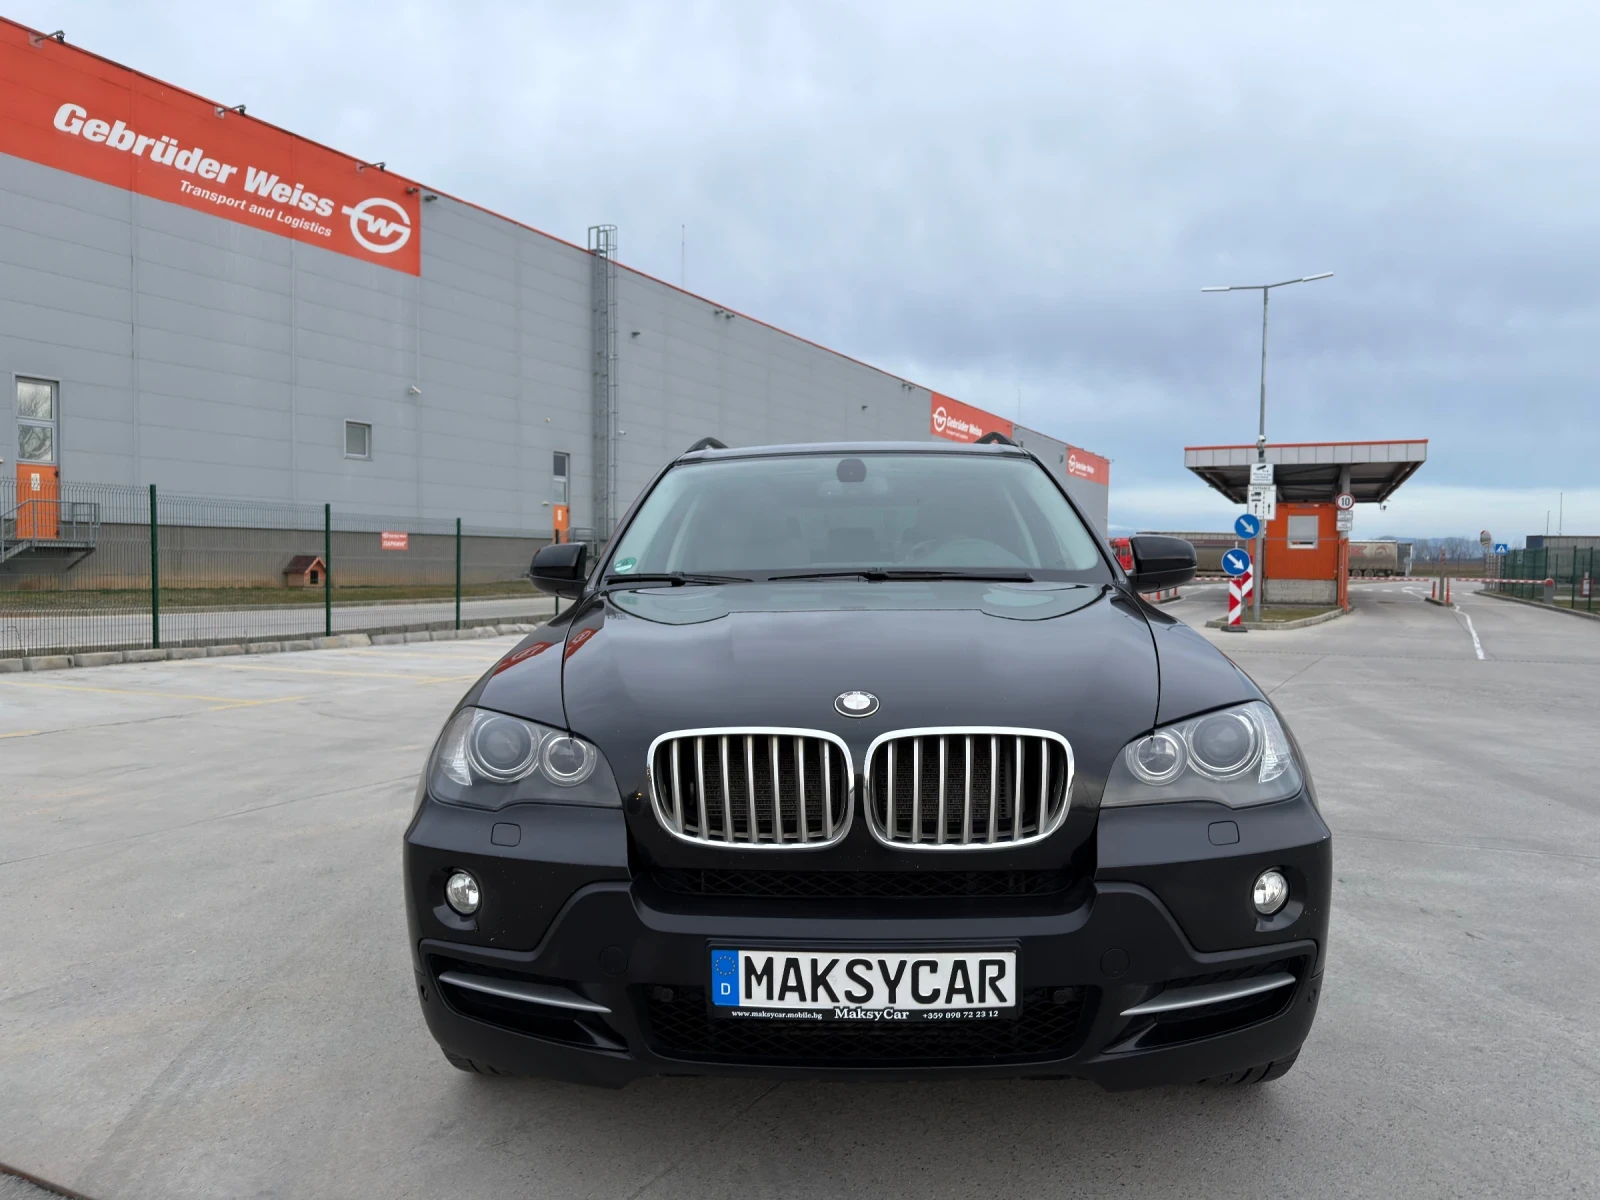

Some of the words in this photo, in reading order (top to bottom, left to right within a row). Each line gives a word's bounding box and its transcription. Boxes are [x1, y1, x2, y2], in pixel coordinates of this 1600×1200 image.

[53, 102, 239, 185] Gebrüder
[243, 165, 334, 217] Weiss
[179, 179, 247, 211] Transport
[248, 203, 275, 219] and
[276, 210, 332, 237] Logistics
[1341, 497, 1351, 506] 10
[744, 955, 1008, 1005] MAKSYCAR
[720, 982, 731, 995] D
[731, 1010, 823, 1020] www.maksycar.mobile.bg
[834, 1007, 910, 1021] MaksyCar
[922, 1012, 943, 1020] +359
[975, 1010, 986, 1018] 23
[988, 1010, 999, 1018] 12
